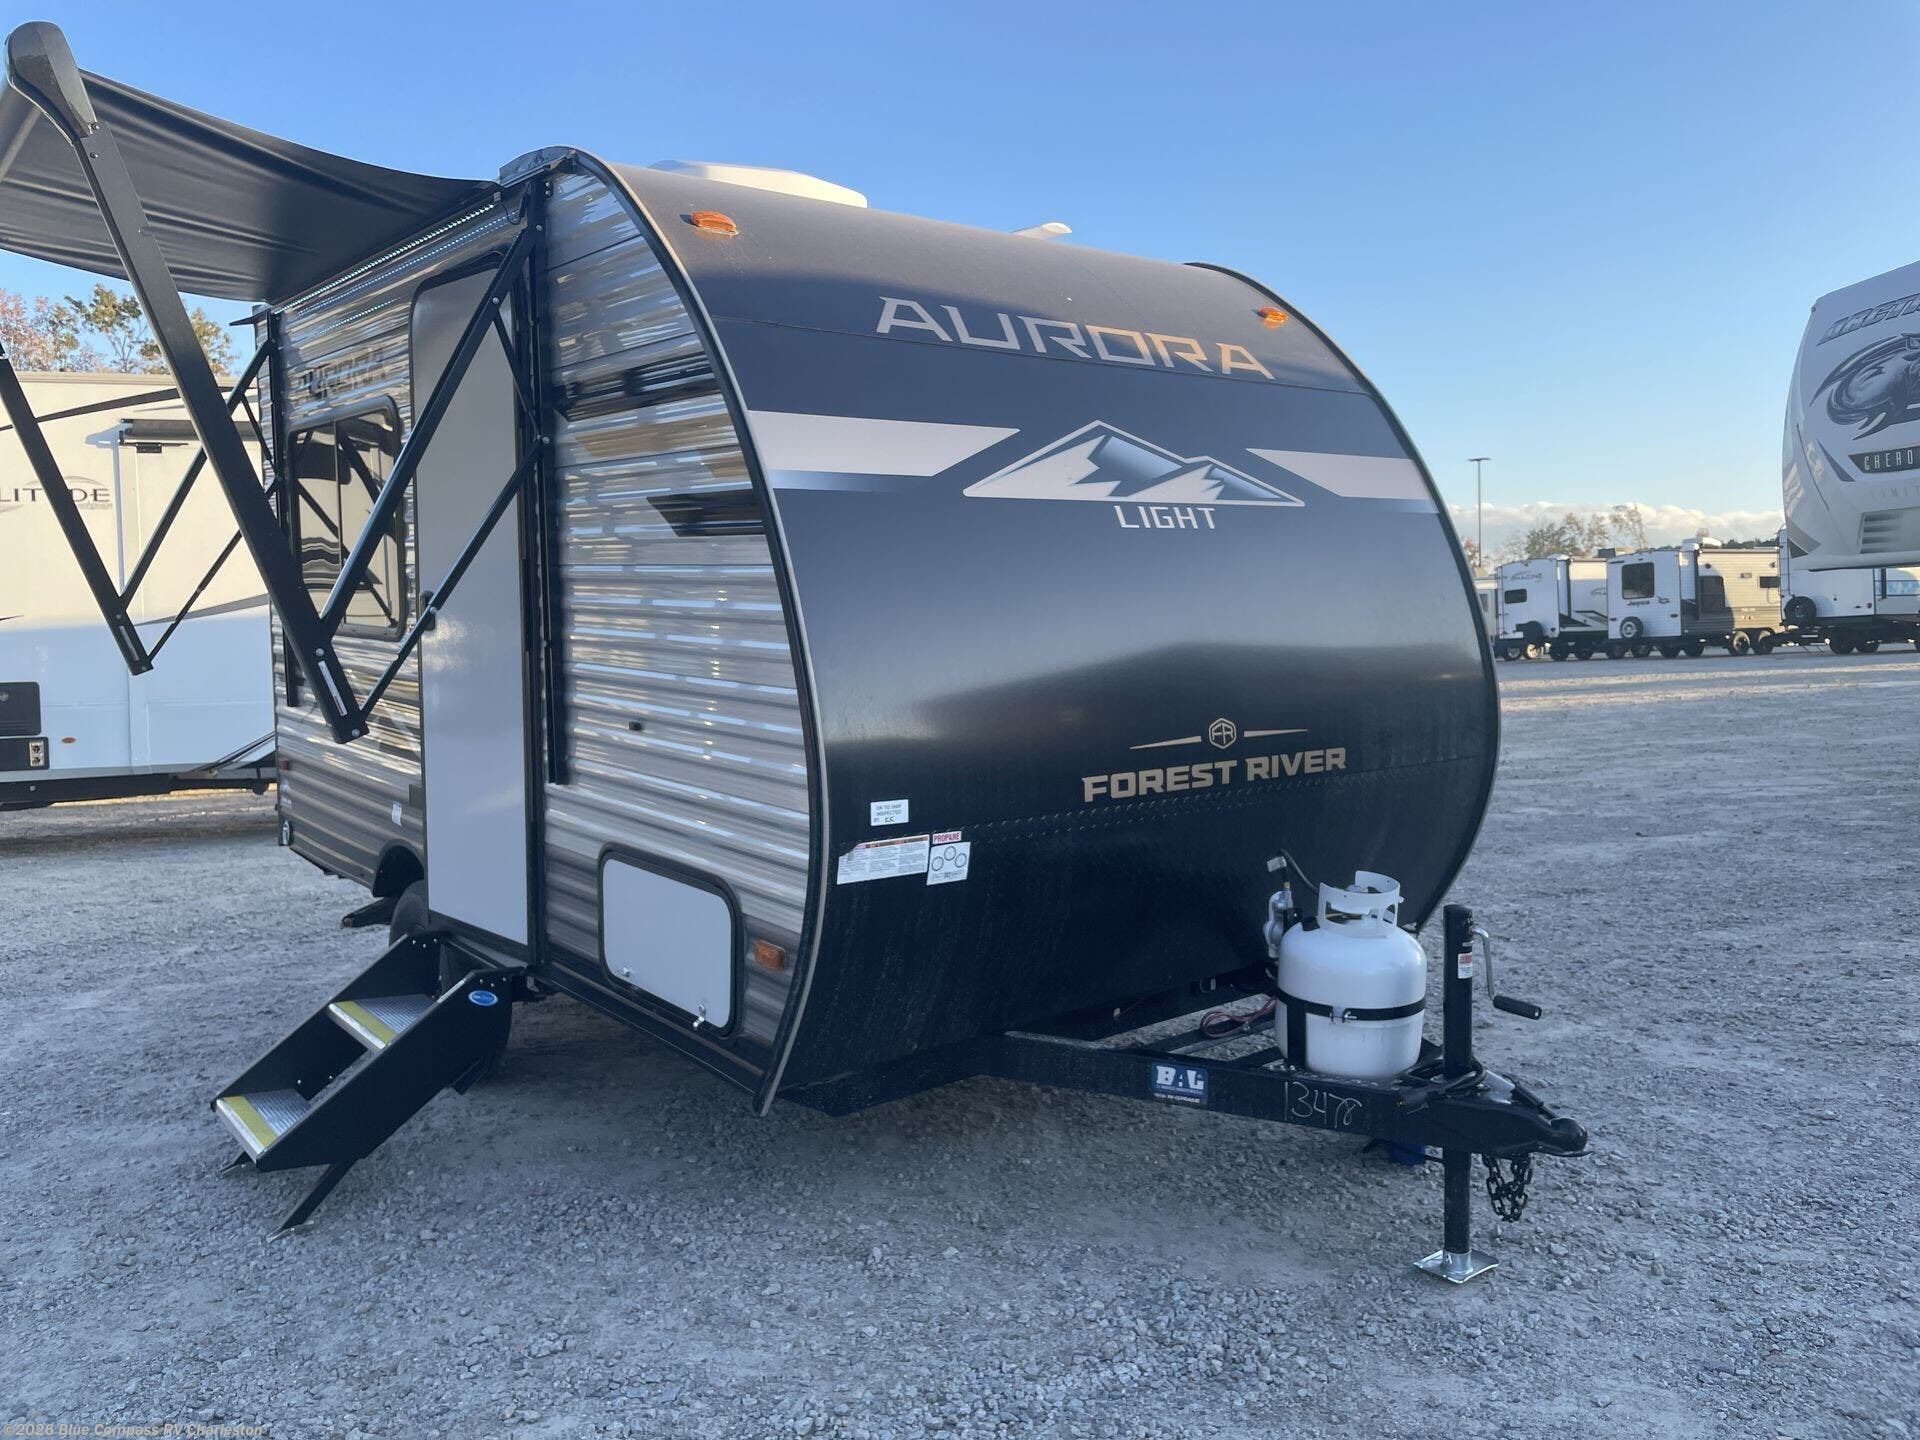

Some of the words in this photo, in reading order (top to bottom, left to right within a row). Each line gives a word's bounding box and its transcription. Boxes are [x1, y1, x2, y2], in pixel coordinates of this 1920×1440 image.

[876, 296, 1275, 380] AURORA
[0, 487, 110, 502] LITDE
[1114, 505, 1217, 530] LIGHT
[1082, 760, 1238, 802] FOREST
[1245, 747, 1346, 782] RIVER
[933, 832, 960, 843] PROPANE
